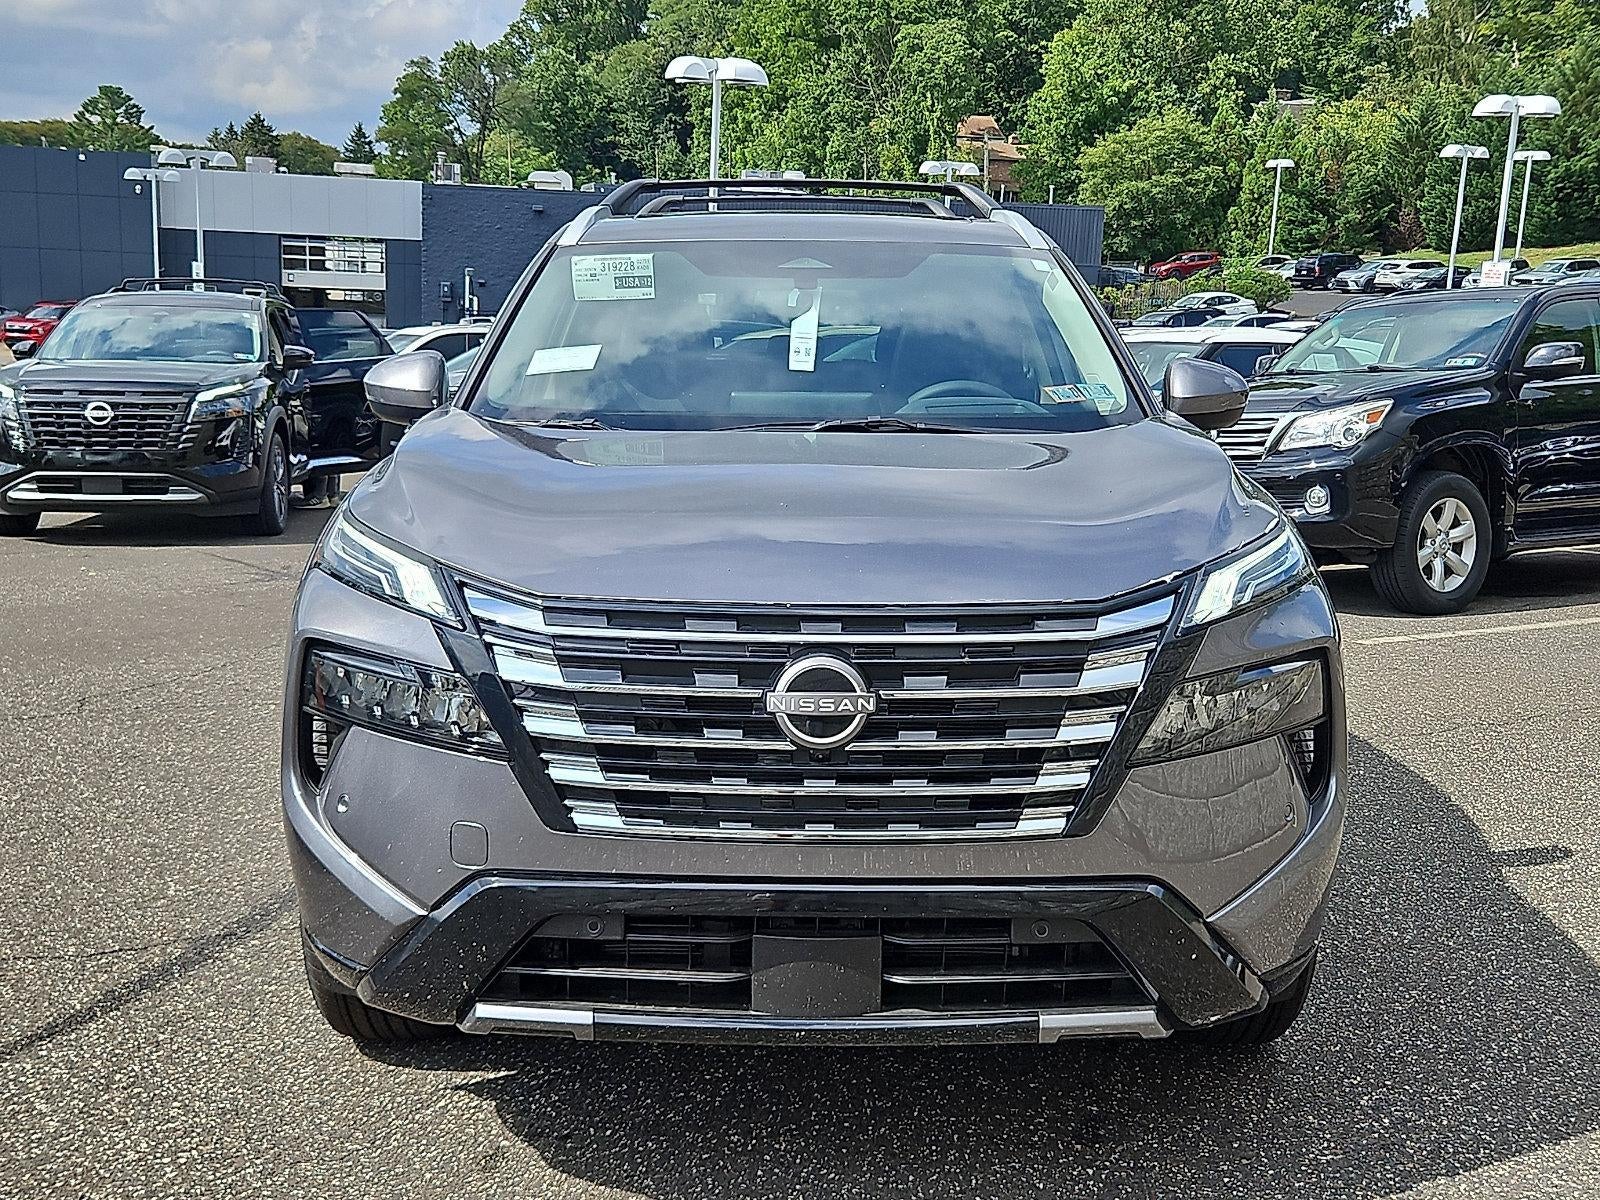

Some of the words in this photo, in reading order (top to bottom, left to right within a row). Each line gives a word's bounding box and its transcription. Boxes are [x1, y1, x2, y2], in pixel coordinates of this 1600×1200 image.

[600, 261, 636, 273] 319228
[622, 276, 641, 288] USA
[769, 696, 874, 712] NISSAN
